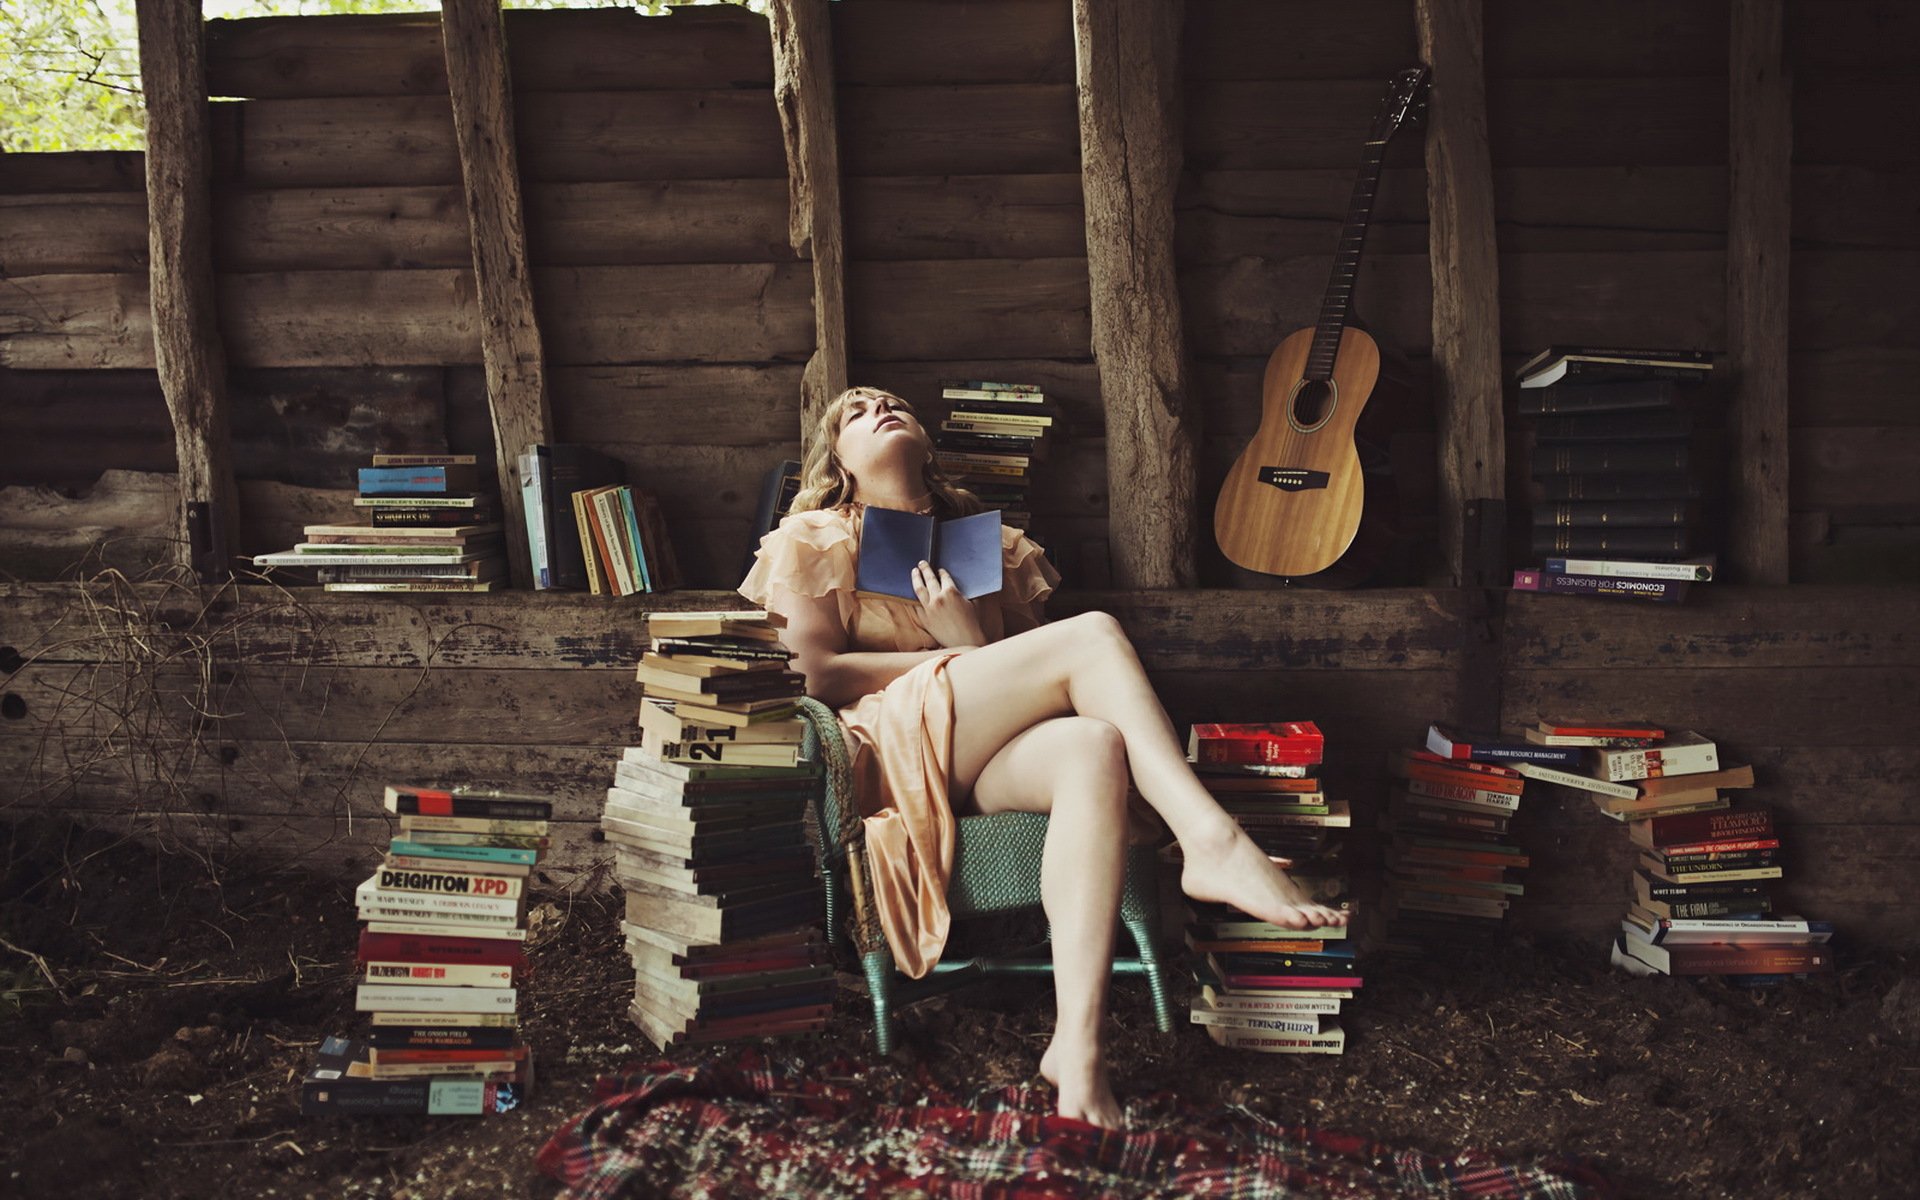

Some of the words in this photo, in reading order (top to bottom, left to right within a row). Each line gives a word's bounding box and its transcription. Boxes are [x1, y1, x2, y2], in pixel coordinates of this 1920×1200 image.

[1556, 576, 1596, 588] BUSINESS
[1598, 580, 1616, 588] FOR
[1616, 582, 1665, 592] ECONOMICS
[706, 726, 736, 740] 1
[690, 743, 722, 760] 2
[1510, 750, 1534, 758] RESOURCE
[1534, 752, 1566, 760] MANAGEMENT
[1711, 817, 1767, 829] CROMWELL
[1689, 863, 1723, 872] UNBORN
[381, 872, 468, 892] DEIGHTON
[473, 878, 508, 894] XPD
[376, 896, 396, 904] MARY
[398, 898, 424, 906] WESLEY
[380, 908, 401, 916] MARY
[403, 910, 432, 918] WESLEY
[1676, 905, 1689, 918] THE
[1691, 903, 1708, 916] FIRM
[1295, 1002, 1311, 1010] BOYD
[1312, 1002, 1336, 1010] WILLIAM
[1248, 1018, 1286, 1032] RENDELL
[1287, 1021, 1313, 1034] RUTH
[1298, 1039, 1310, 1048] THE
[1312, 1040, 1340, 1048] LUDLUM
